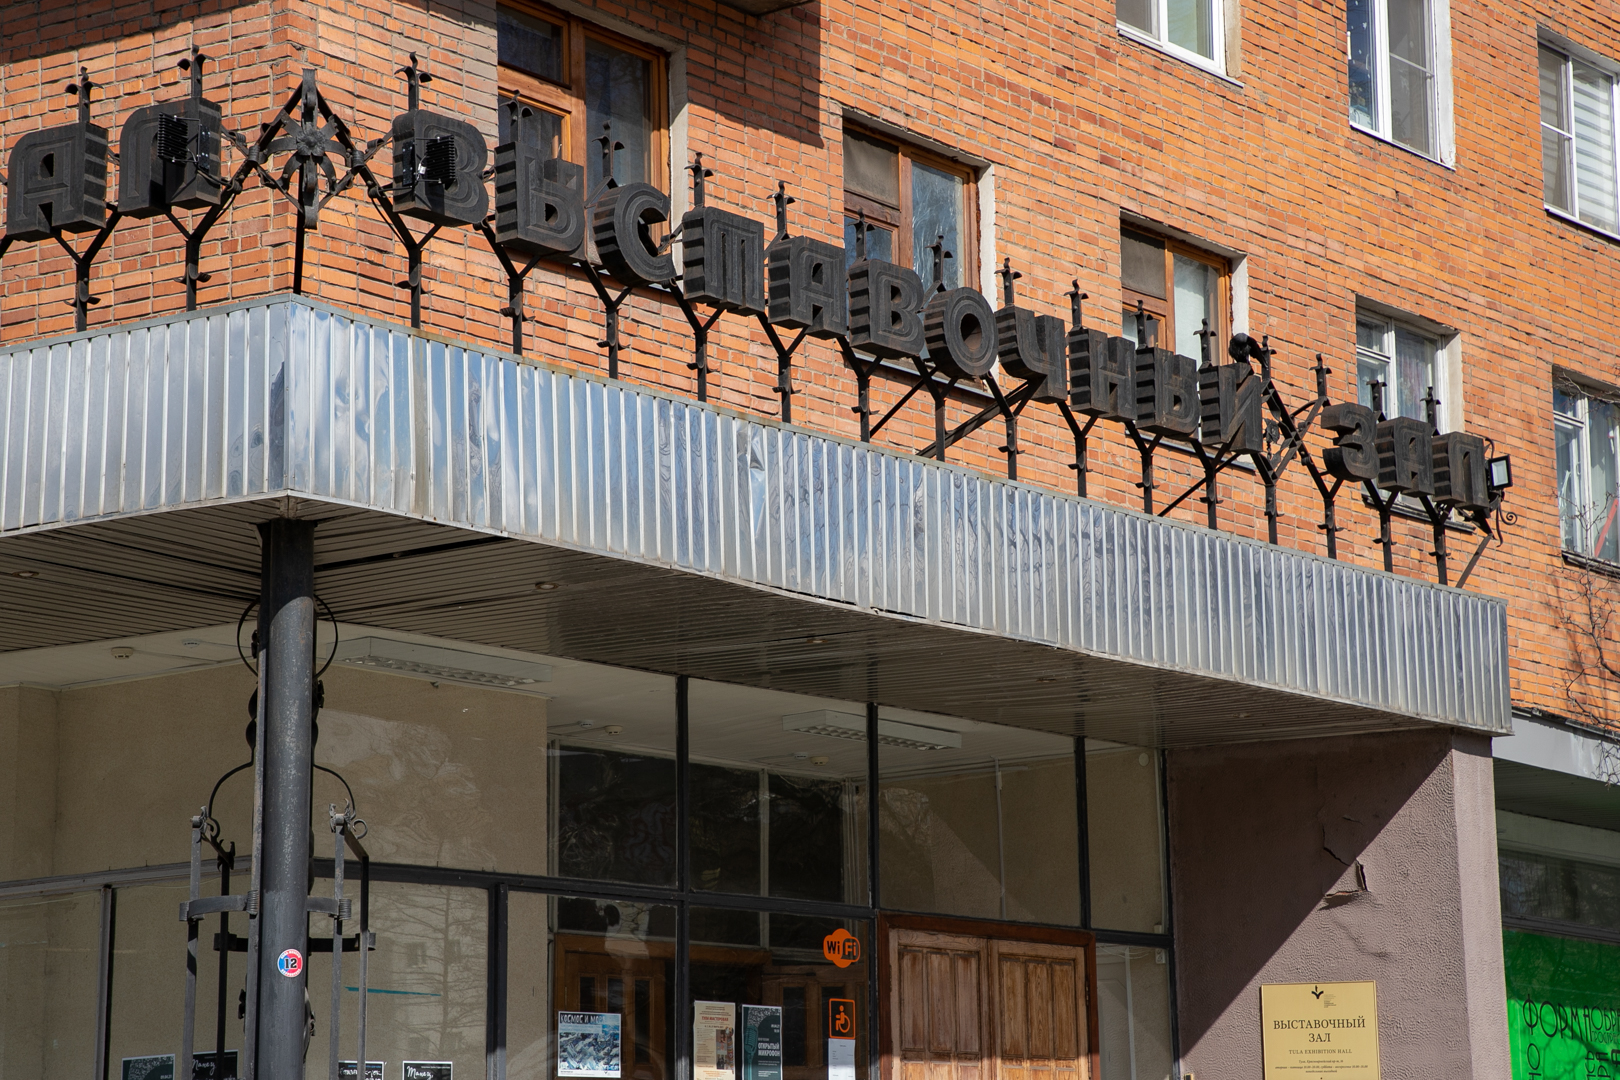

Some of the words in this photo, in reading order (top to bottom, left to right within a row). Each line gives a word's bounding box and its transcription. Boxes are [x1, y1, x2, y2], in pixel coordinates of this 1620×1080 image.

[1321, 402, 1490, 511] ЗАЛ
[284, 958, 298, 969] 12
[1273, 1016, 1365, 1029] ВЫСТАВОЧНЫЙ
[1308, 1032, 1331, 1043] ЗАЛ
